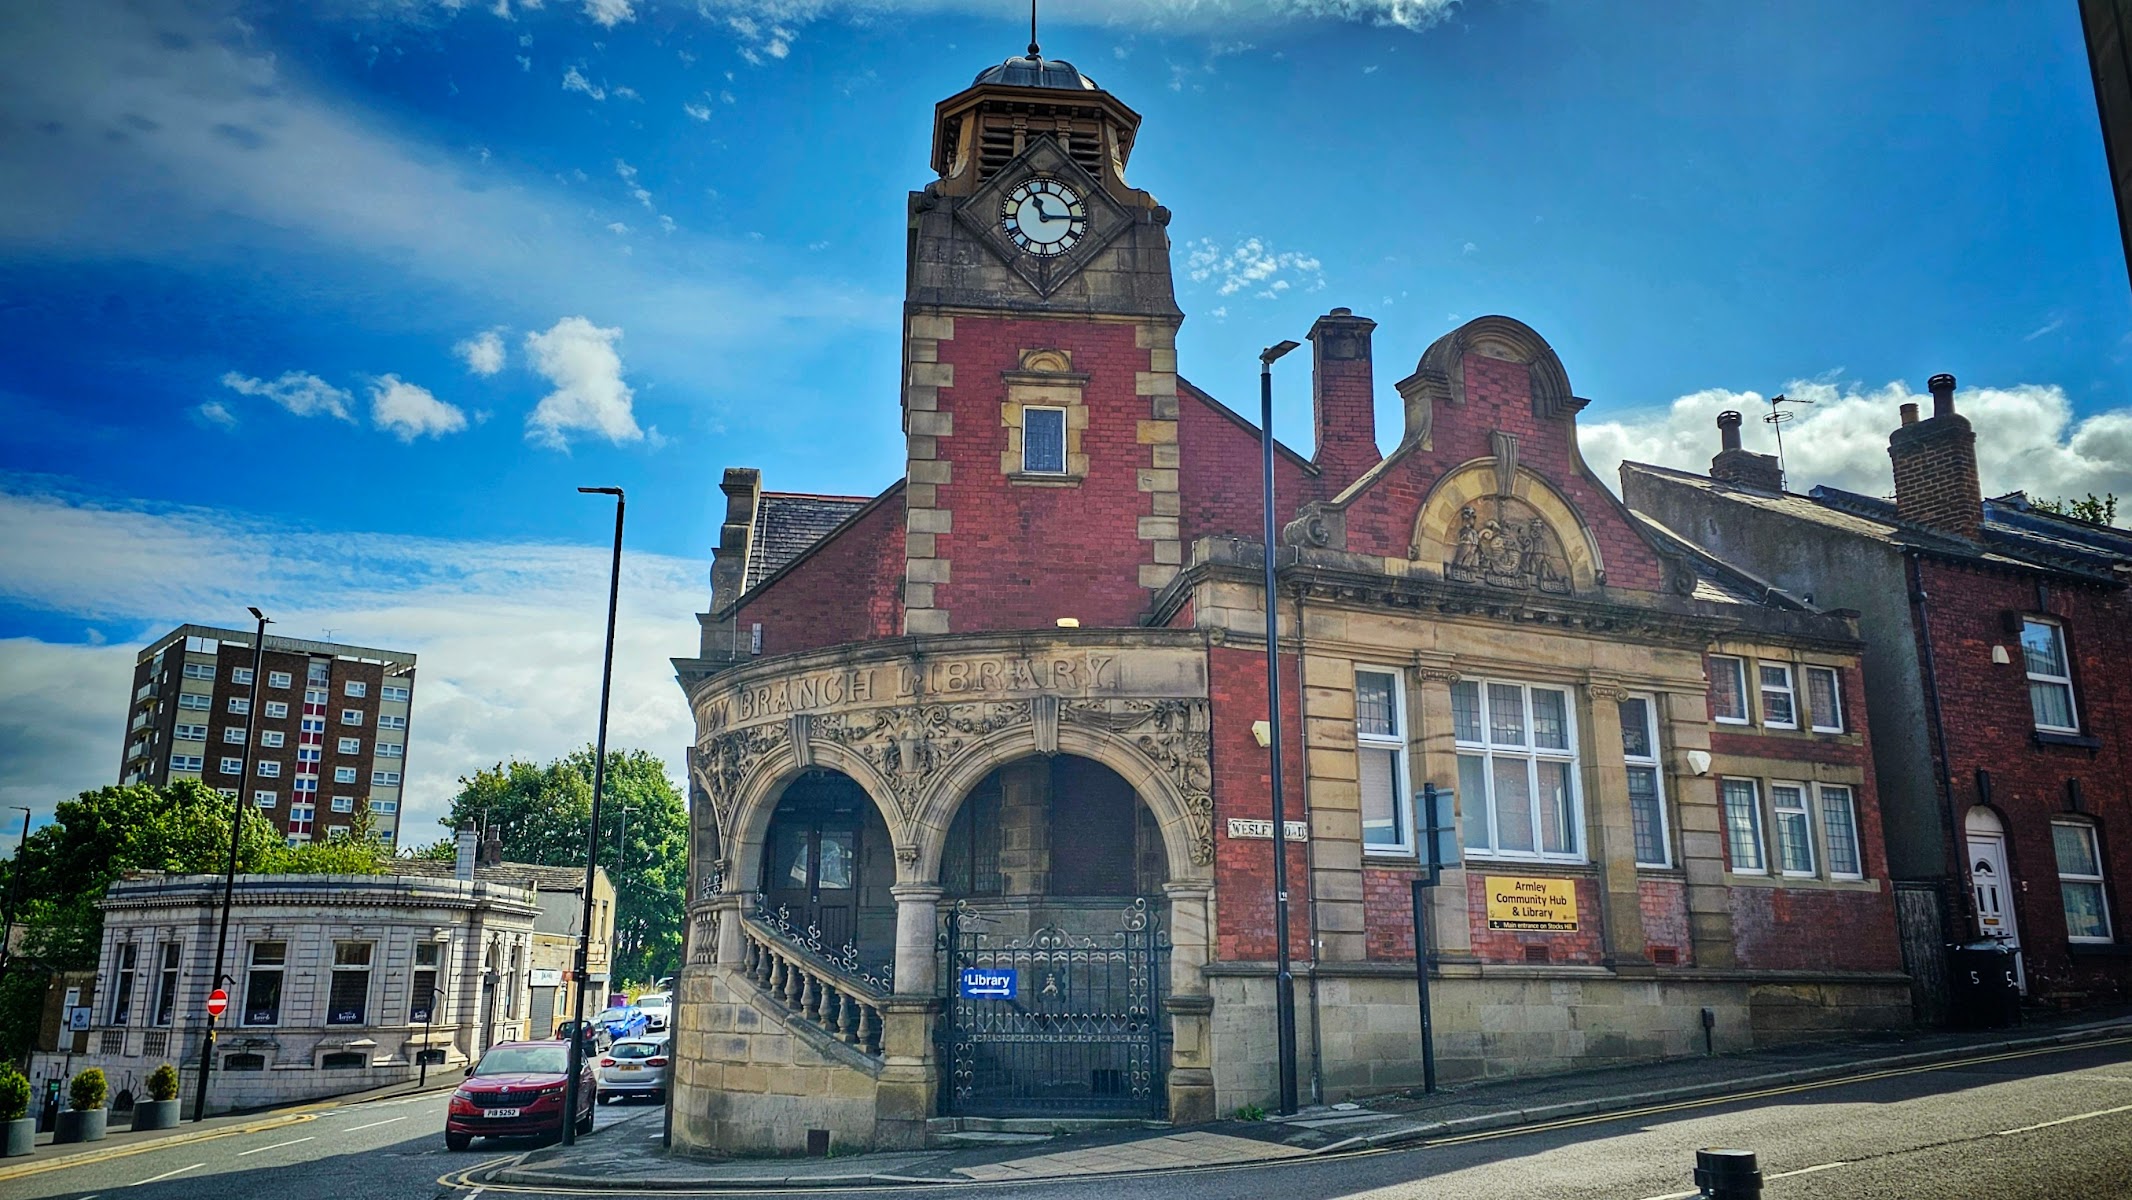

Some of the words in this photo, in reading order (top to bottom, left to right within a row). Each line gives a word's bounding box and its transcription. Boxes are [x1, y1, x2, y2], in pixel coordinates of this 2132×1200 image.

[738, 669, 875, 722] BRANCH
[1232, 823, 1273, 836] WESLE
[1284, 826, 1305, 837] OAD
[1515, 881, 1546, 894] Armley
[1496, 893, 1547, 906] Community
[1550, 895, 1567, 905] Hub
[1512, 906, 1520, 916] &
[1522, 907, 1553, 919] Library
[968, 974, 1010, 988] Library
[1970, 971, 1980, 984] 5
